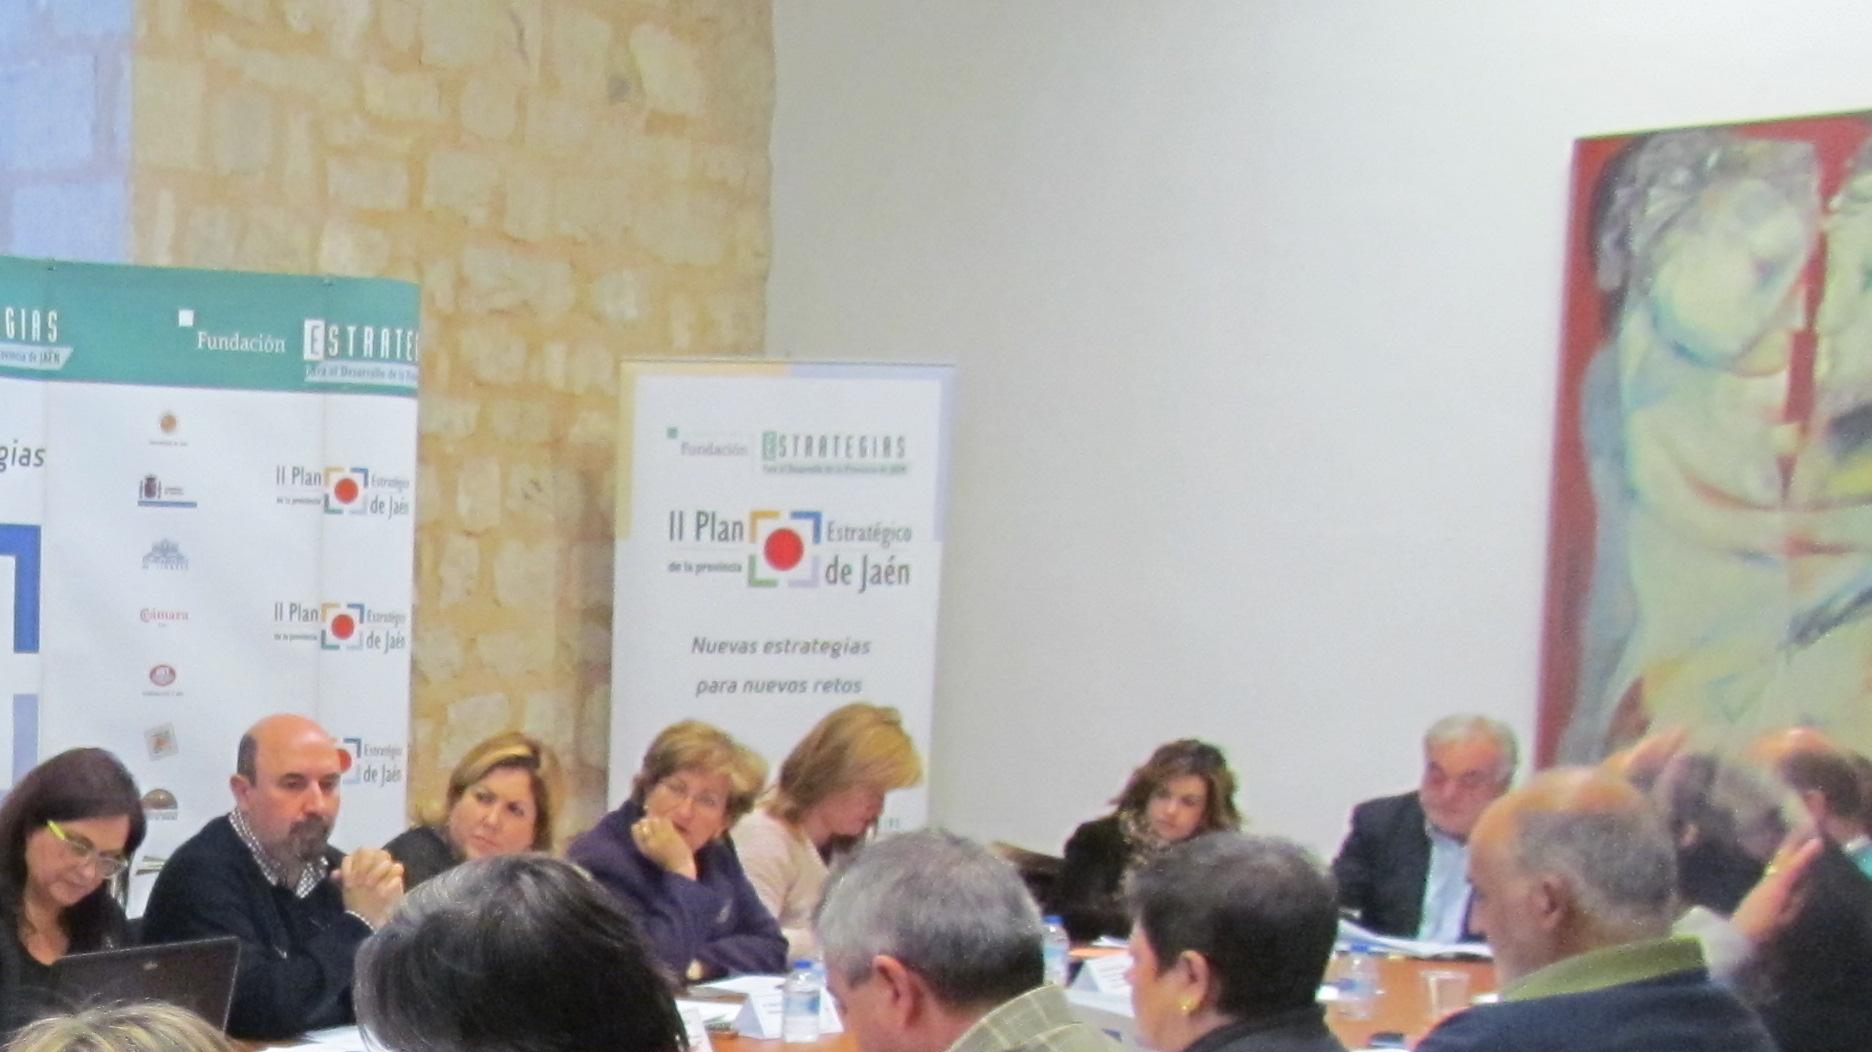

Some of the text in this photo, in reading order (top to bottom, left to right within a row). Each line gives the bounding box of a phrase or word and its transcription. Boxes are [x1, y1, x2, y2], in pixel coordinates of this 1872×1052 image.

[197, 331, 286, 353] Fundación
[305, 321, 419, 361] ESTRATE
[680, 441, 748, 456] Fundación
[762, 431, 906, 461] ESTRATEGIAS
[291, 467, 322, 486] Plan
[669, 510, 744, 542] II Plan
[827, 520, 912, 549] Estratégico
[668, 561, 742, 575] de la provincia
[826, 555, 910, 594] de Jaén
[290, 602, 319, 622] Plan
[385, 630, 406, 653] Jaén
[691, 637, 871, 659] Nuevas estrategias
[695, 679, 863, 697] para nuevos retos
[381, 765, 402, 787] Jaén
